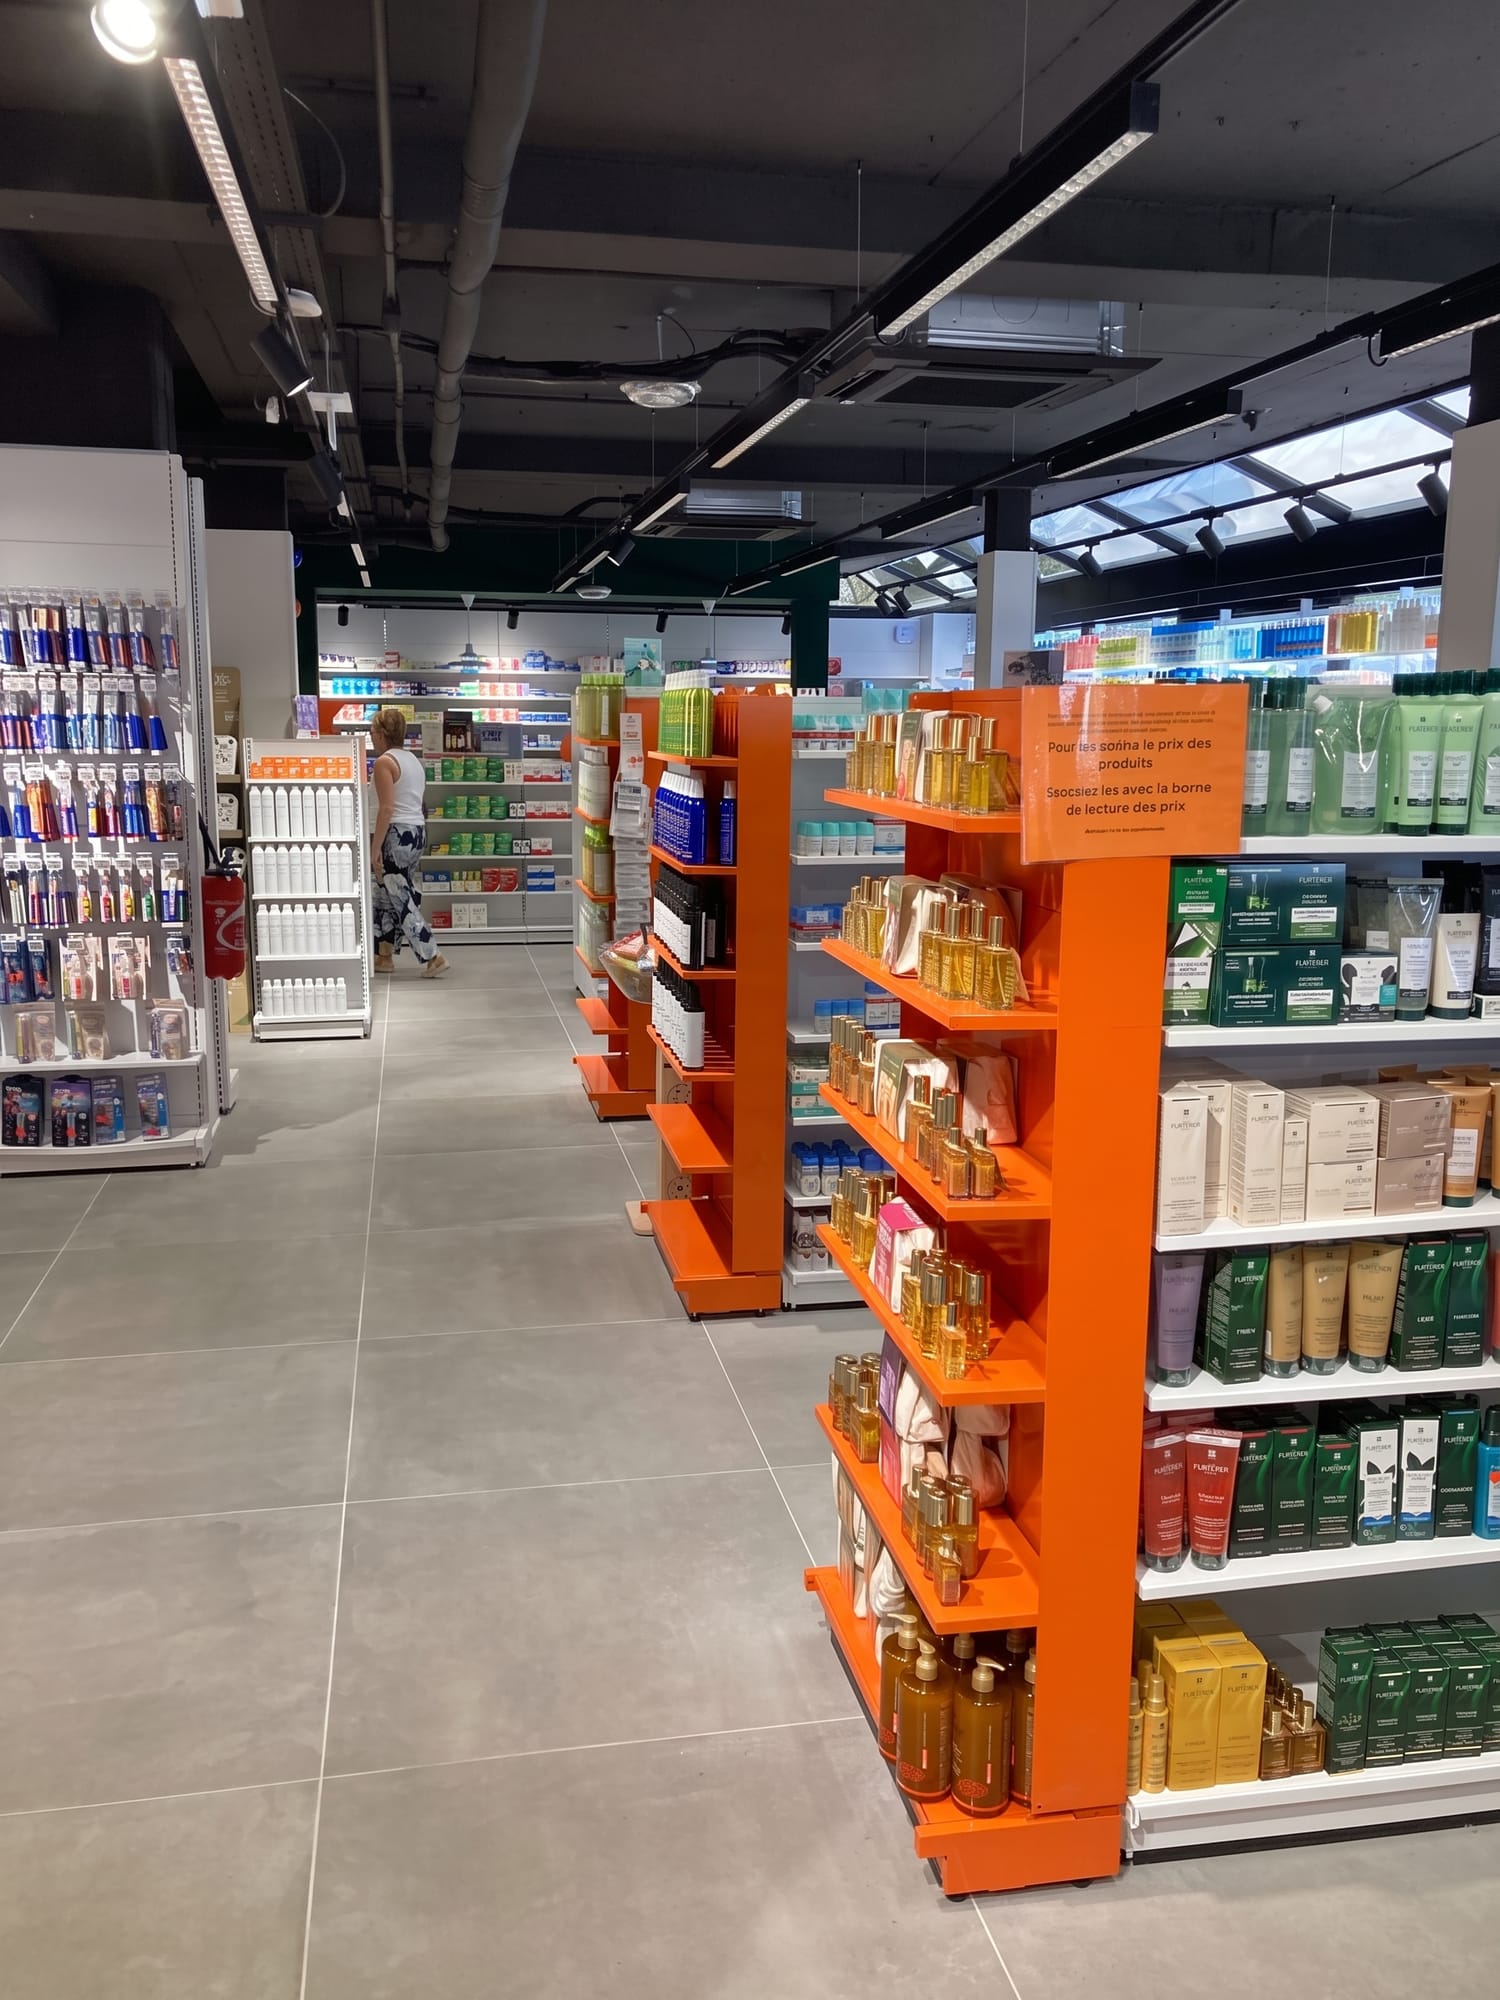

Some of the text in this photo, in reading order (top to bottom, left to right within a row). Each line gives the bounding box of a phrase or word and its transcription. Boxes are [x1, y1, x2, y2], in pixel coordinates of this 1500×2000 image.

[1048, 742, 1076, 753] Pour
[1143, 739, 1155, 750] le
[1158, 738, 1184, 752] prix
[1187, 737, 1212, 749] des
[1099, 757, 1153, 771] produits
[1101, 785, 1119, 796] les
[1122, 785, 1153, 795] avec
[1157, 782, 1168, 794] la
[1172, 782, 1212, 793] borne
[1066, 800, 1185, 816] de lecture des prix
